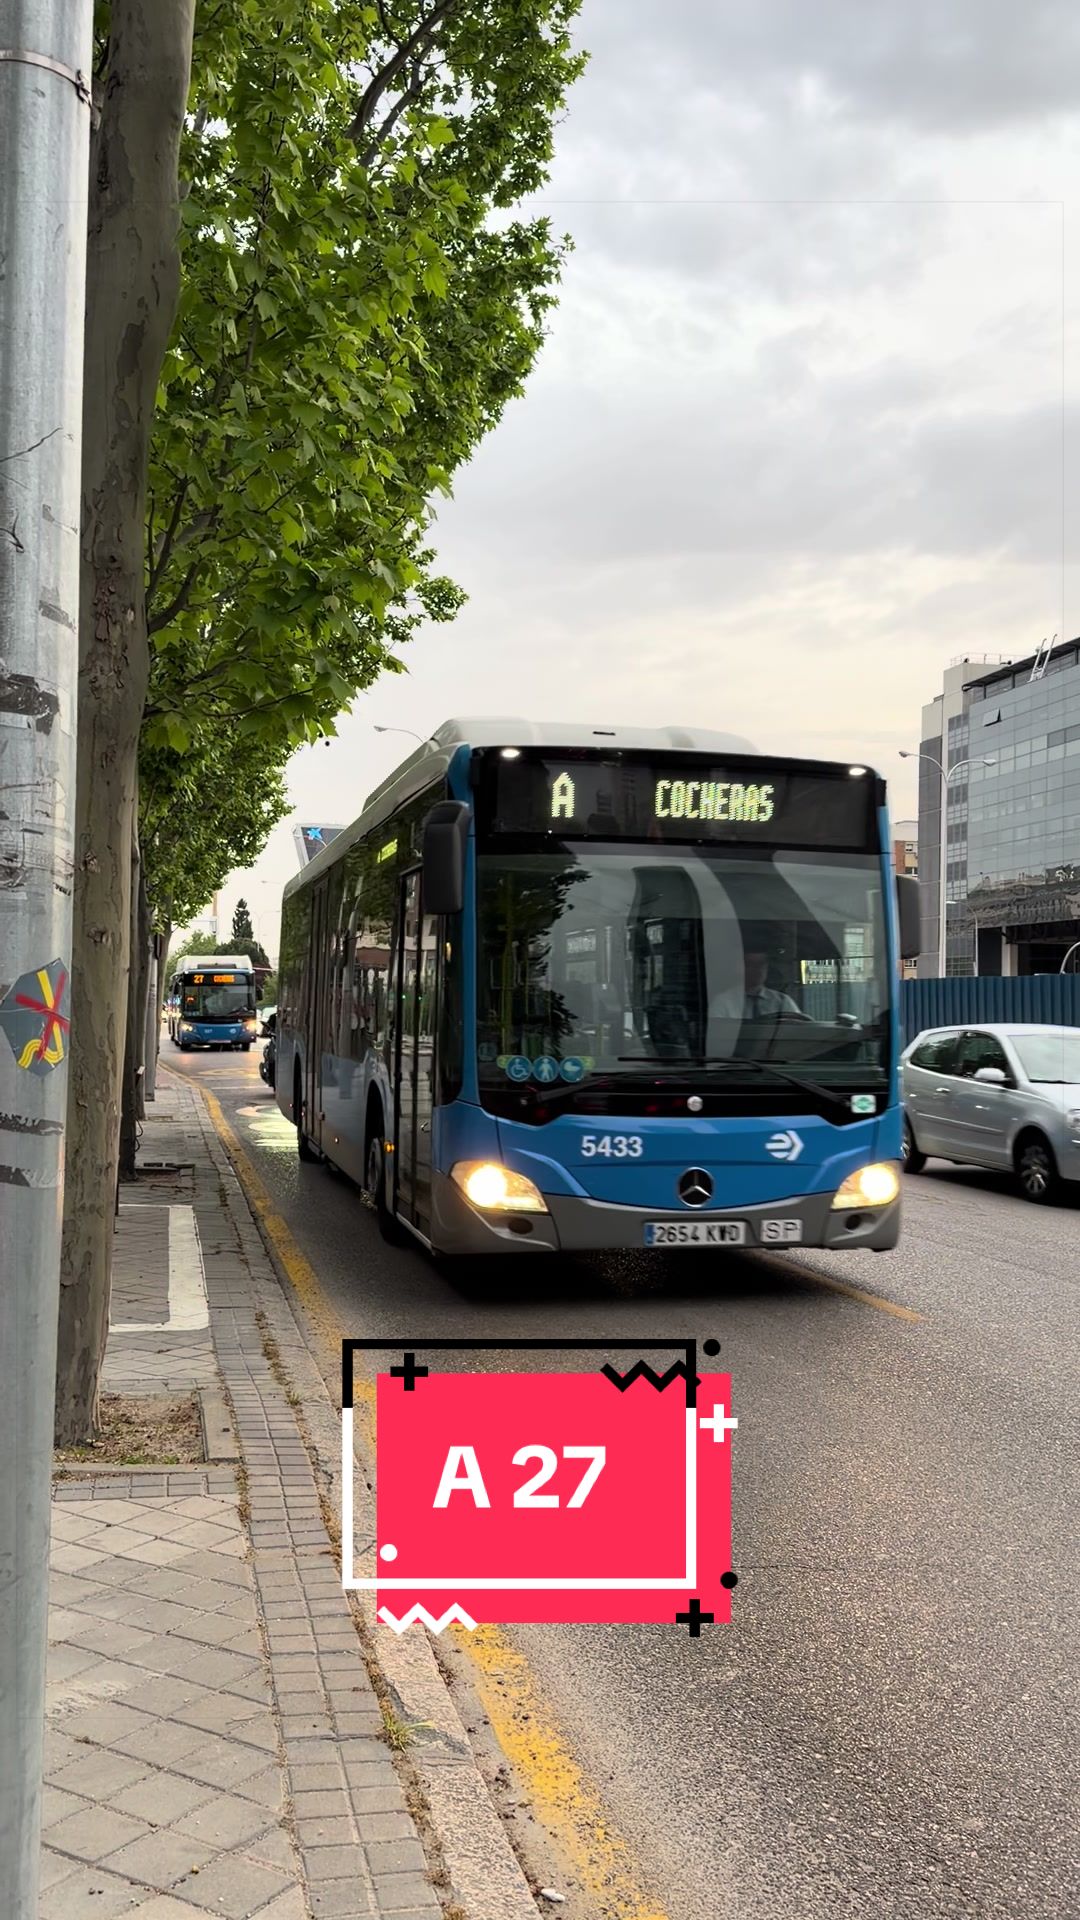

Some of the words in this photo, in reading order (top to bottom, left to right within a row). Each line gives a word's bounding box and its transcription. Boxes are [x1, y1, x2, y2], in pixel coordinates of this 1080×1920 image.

[551, 772, 575, 818] A
[655, 780, 774, 822] COCHERAS
[193, 974, 204, 984] 27
[580, 1135, 643, 1158] 5433
[656, 1225, 700, 1243] 2654
[766, 1221, 798, 1240] SP
